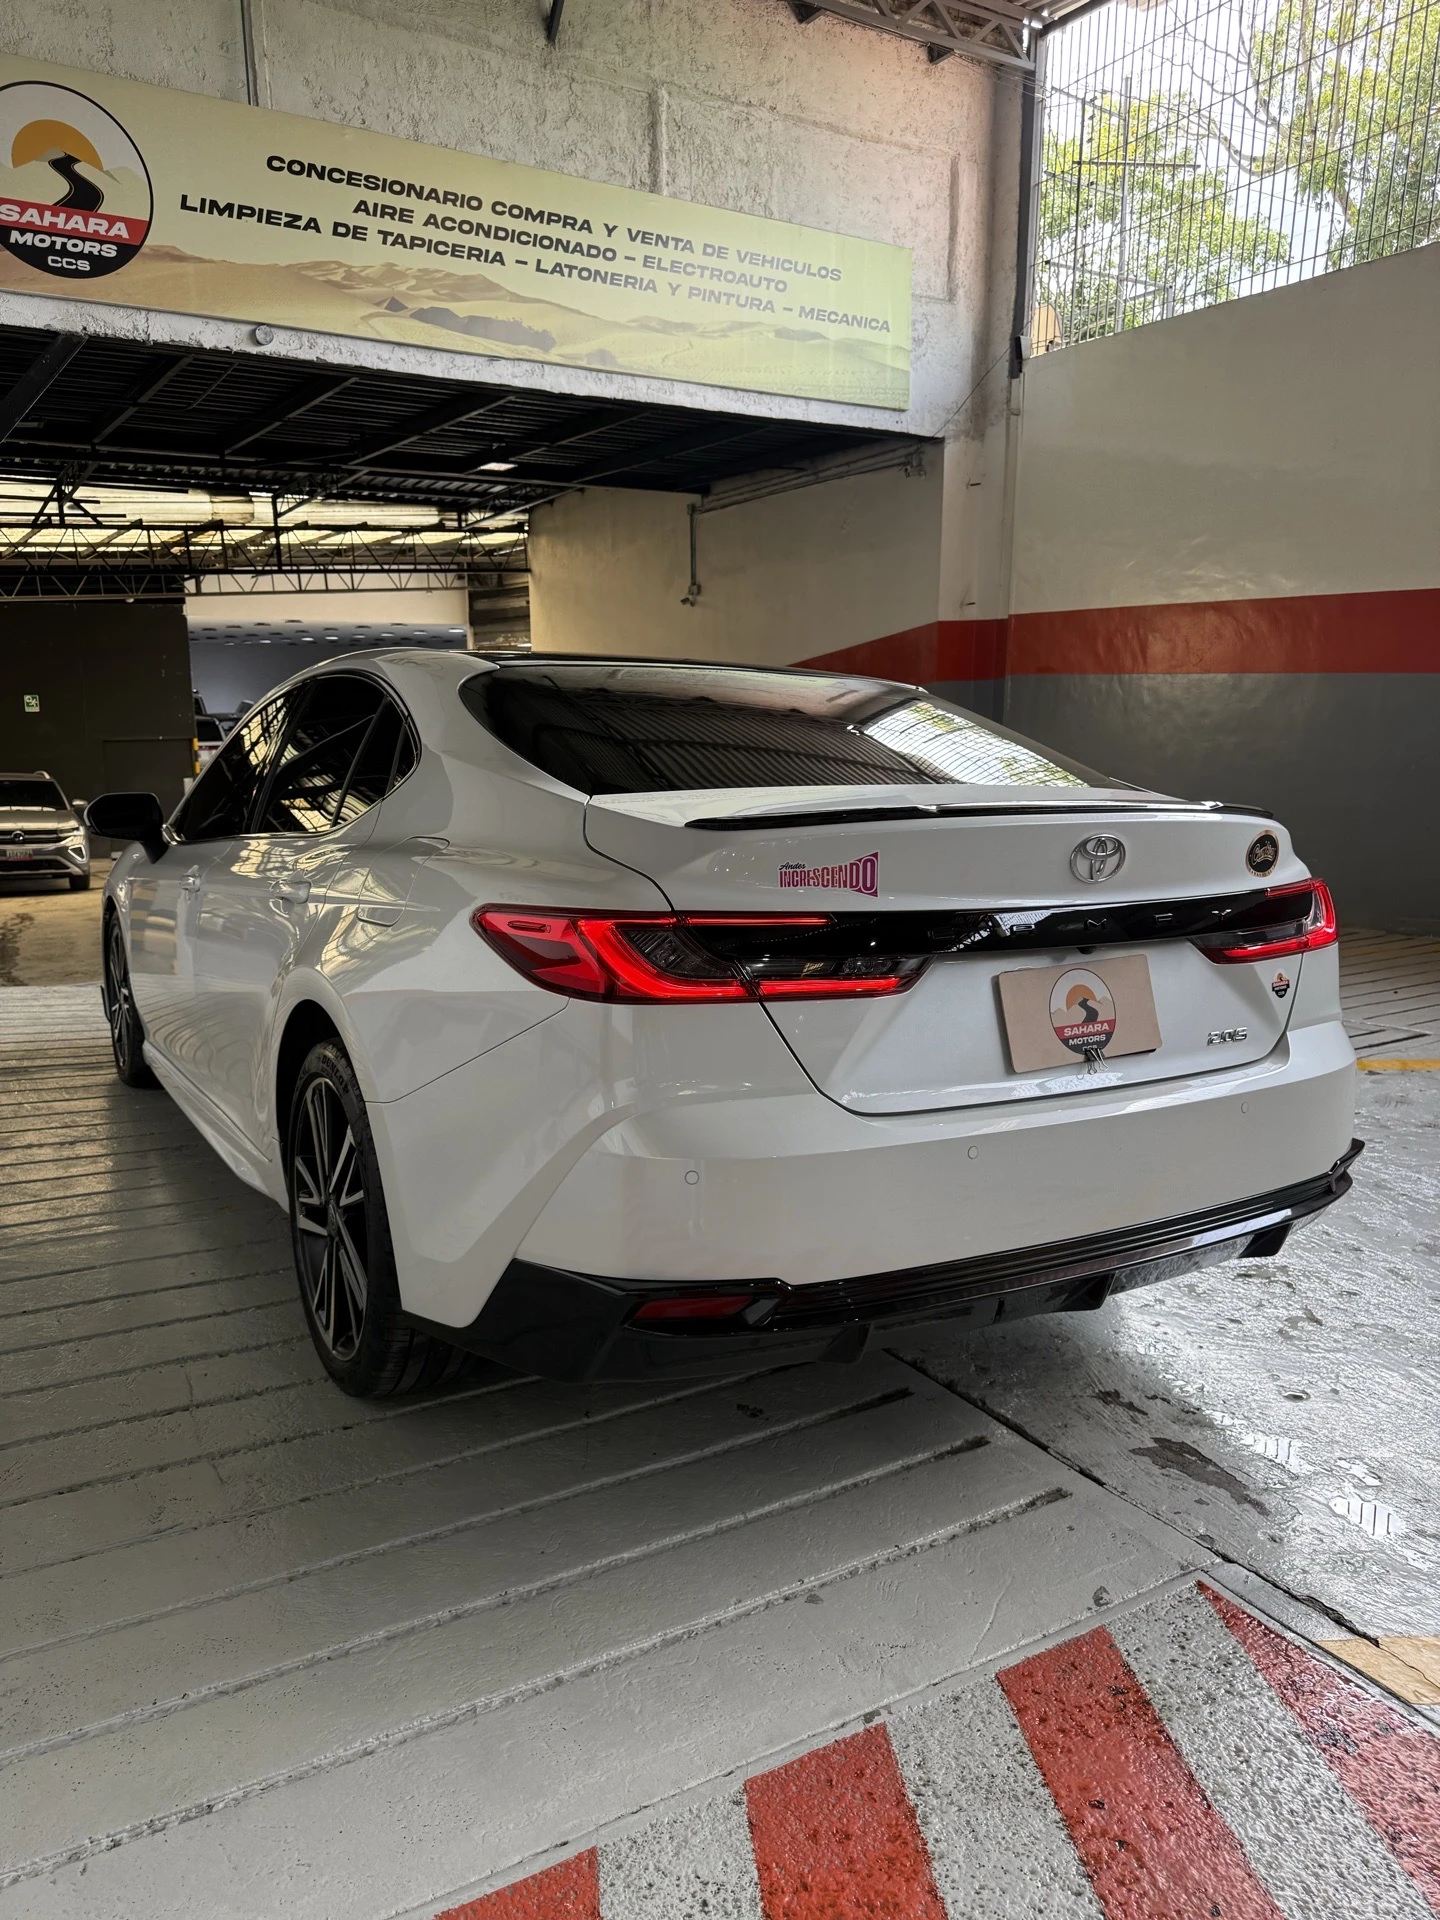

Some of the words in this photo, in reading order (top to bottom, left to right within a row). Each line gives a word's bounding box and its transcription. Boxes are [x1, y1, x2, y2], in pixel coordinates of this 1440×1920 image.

[0, 204, 130, 239] SAHARA
[266, 155, 483, 211] CONCESIONARIO
[490, 200, 593, 234] COMPRA
[602, 222, 619, 238] Y
[626, 227, 695, 254] VENTA
[701, 242, 730, 260] DE
[735, 249, 842, 282] VEHICULOS
[9, 230, 118, 258] MOTORS
[352, 199, 415, 224] AIRE
[422, 213, 617, 262] ACONDICIONADO
[642, 254, 788, 293] ELECTROAUTO
[47, 255, 91, 272] CCS
[180, 194, 322, 234] LIMPIEZA
[331, 221, 369, 242] DE
[377, 229, 506, 267] TAPICERIA
[535, 258, 658, 294] LATONERIA
[667, 281, 682, 297] Y
[687, 286, 775, 314] PINTURA
[798, 305, 891, 333] MECANICA
[778, 861, 807, 871] Andes
[779, 855, 878, 894] INCRESCENDO
[1063, 1022, 1110, 1037] SAHARA
[1068, 1034, 1106, 1046] MOTORS
